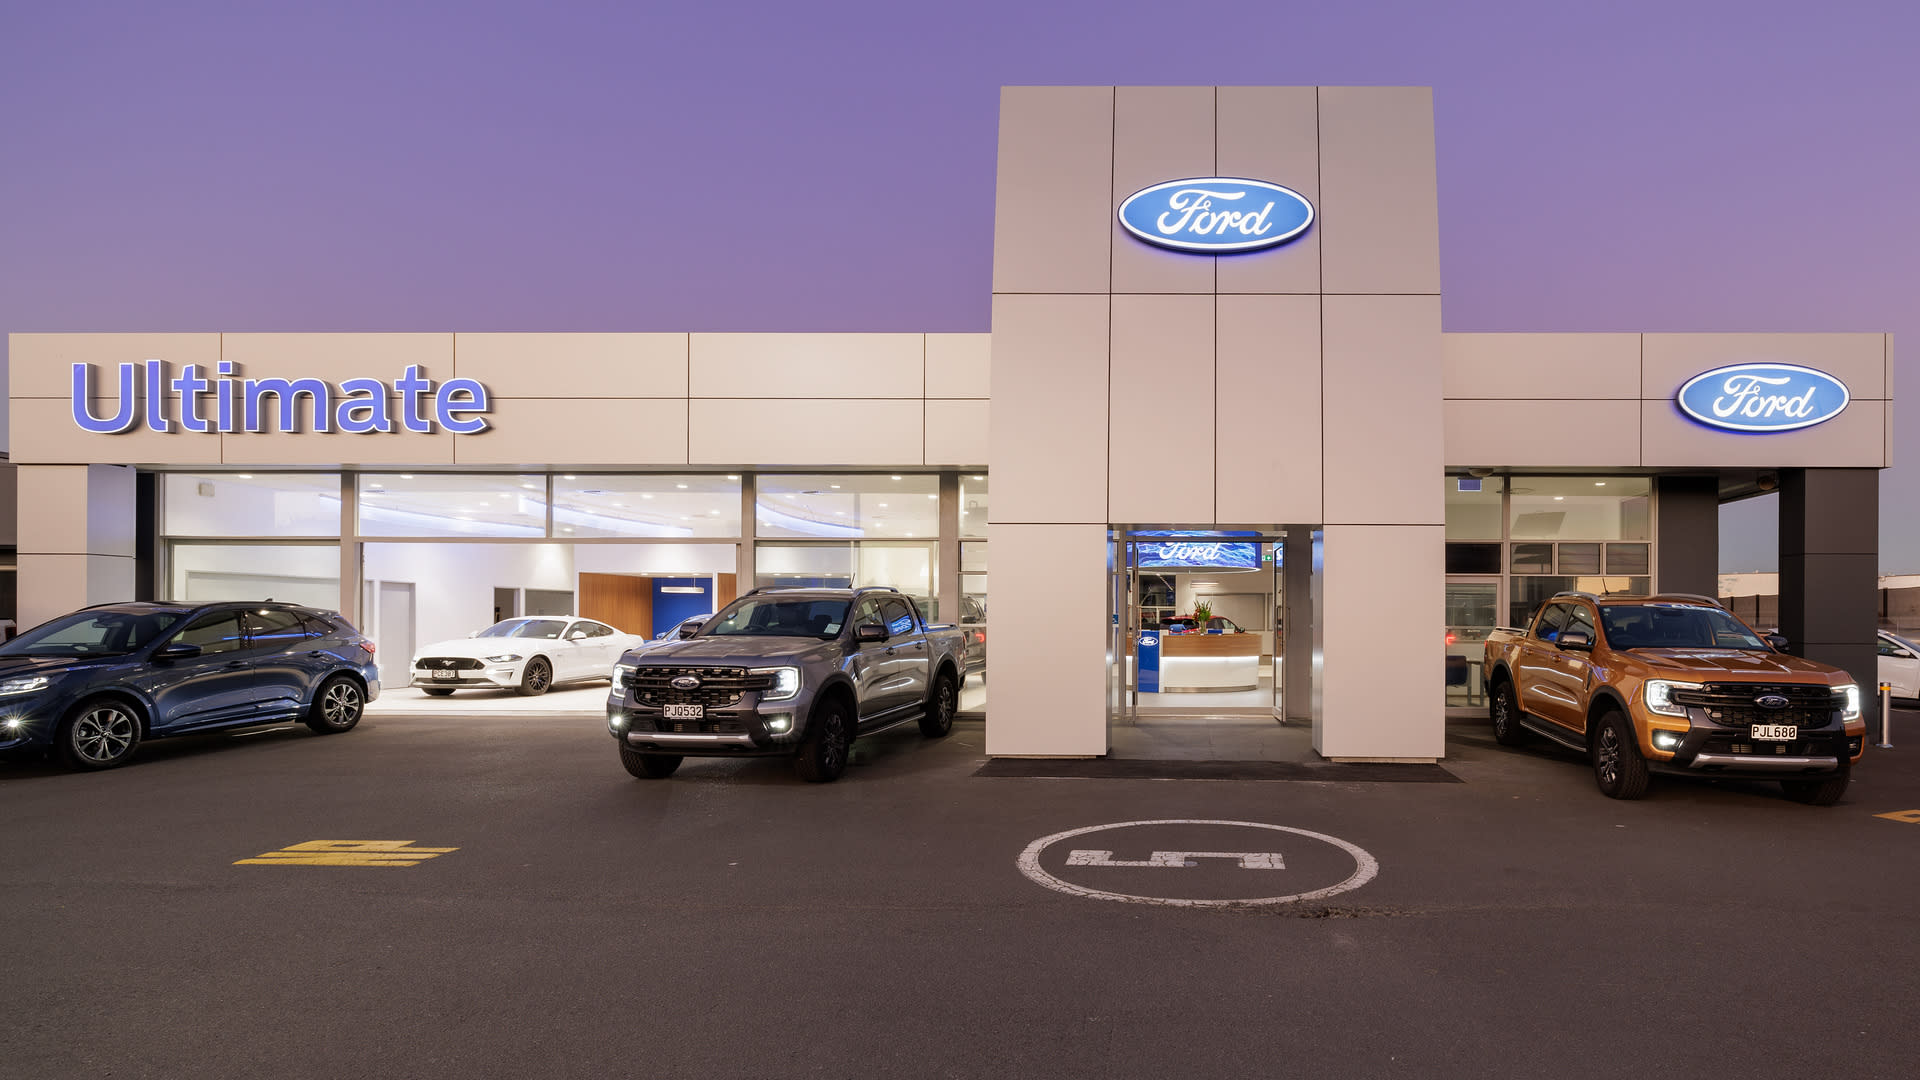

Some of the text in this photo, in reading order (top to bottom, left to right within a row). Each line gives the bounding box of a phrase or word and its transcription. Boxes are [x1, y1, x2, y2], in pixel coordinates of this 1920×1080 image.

[1156, 189, 1275, 235] Ford
[71, 359, 490, 434] Ultimate
[1712, 374, 1817, 418] Ford
[664, 706, 703, 717] PJQ532
[1752, 726, 1796, 738] PJL680
